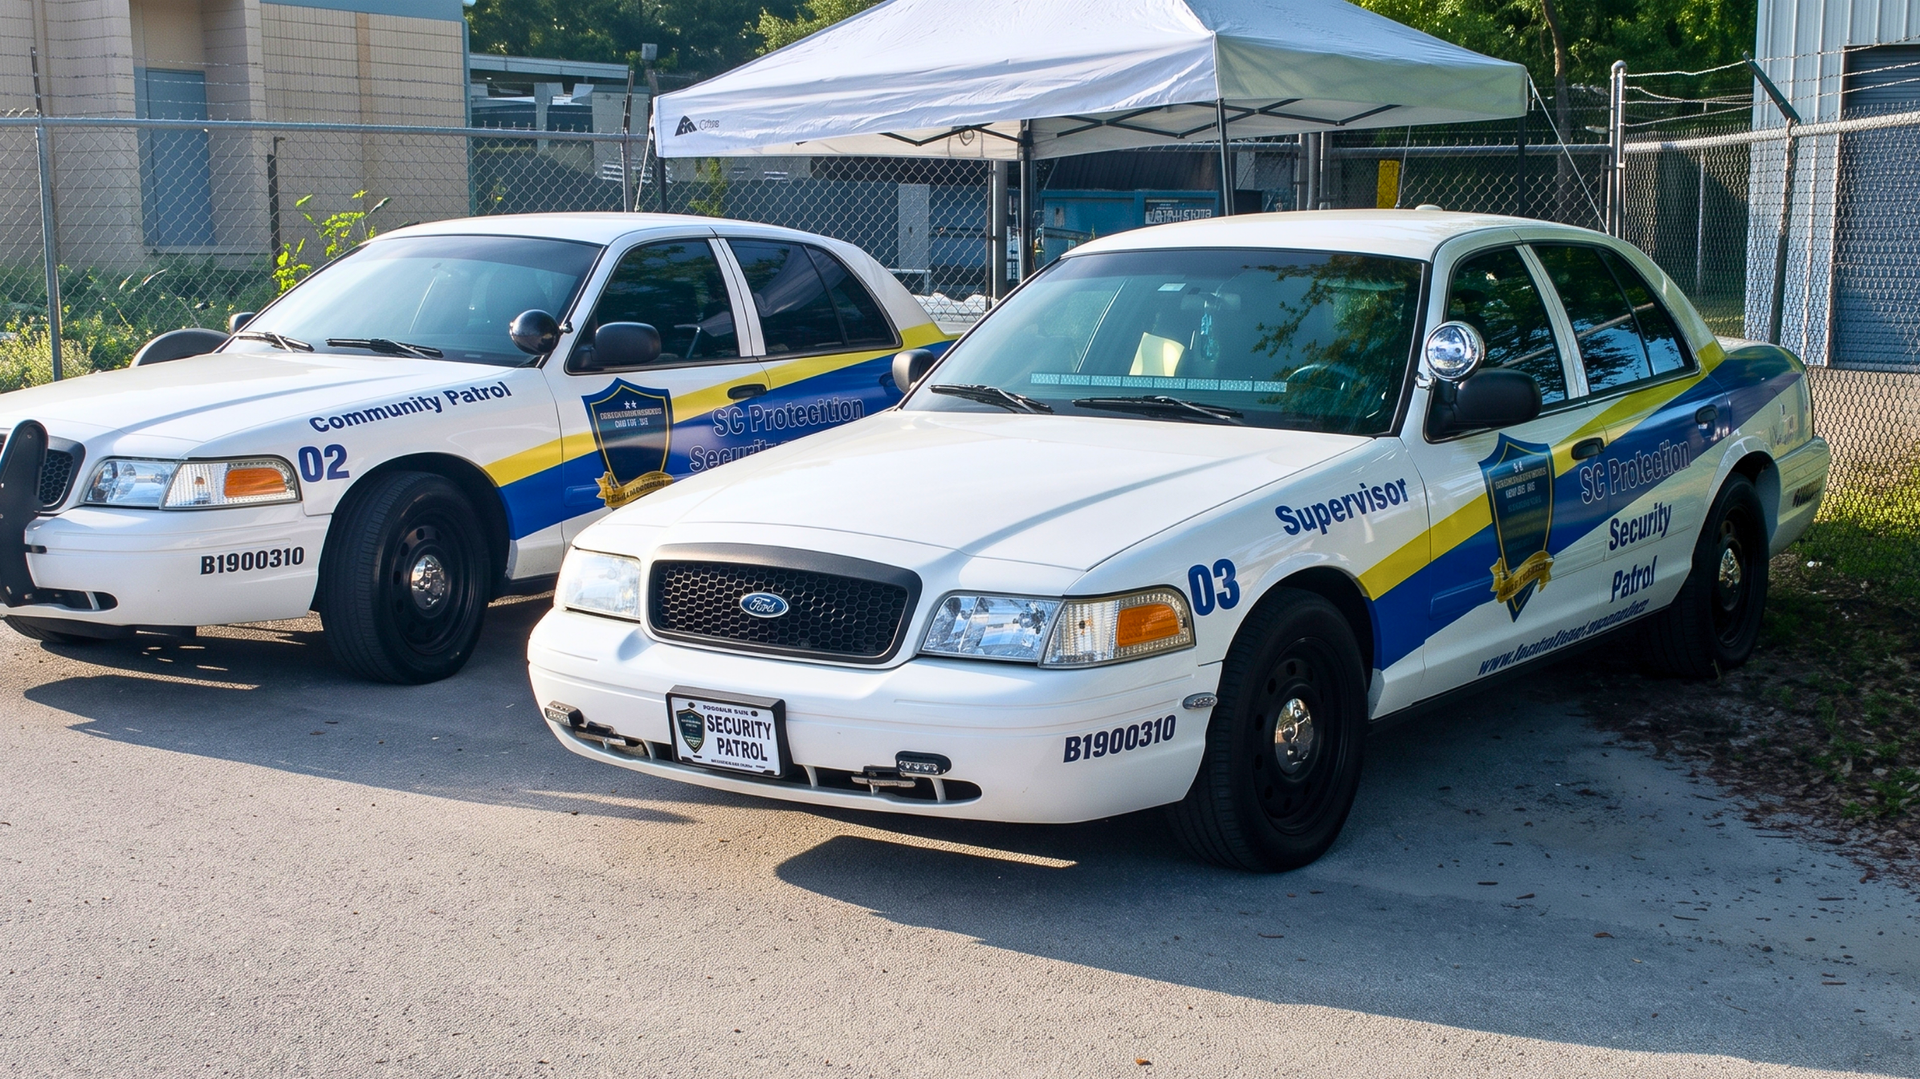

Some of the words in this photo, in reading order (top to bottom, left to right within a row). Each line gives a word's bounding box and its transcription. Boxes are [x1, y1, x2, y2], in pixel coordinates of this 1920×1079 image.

[309, 395, 443, 433] Community
[443, 381, 513, 406] Patrol
[712, 407, 745, 437] SC
[298, 443, 350, 483] 02
[1580, 462, 1606, 505] SC
[1607, 439, 1691, 496] Protection
[1275, 478, 1410, 536] Supervisor
[1609, 501, 1672, 551] Security
[200, 546, 305, 575] B1900310
[1609, 554, 1658, 604] Patrol
[749, 596, 777, 613] Ford
[1188, 559, 1241, 617] 03
[706, 714, 772, 740] SECURITY
[716, 737, 768, 762] PATROL
[1063, 714, 1177, 763] B1900310
